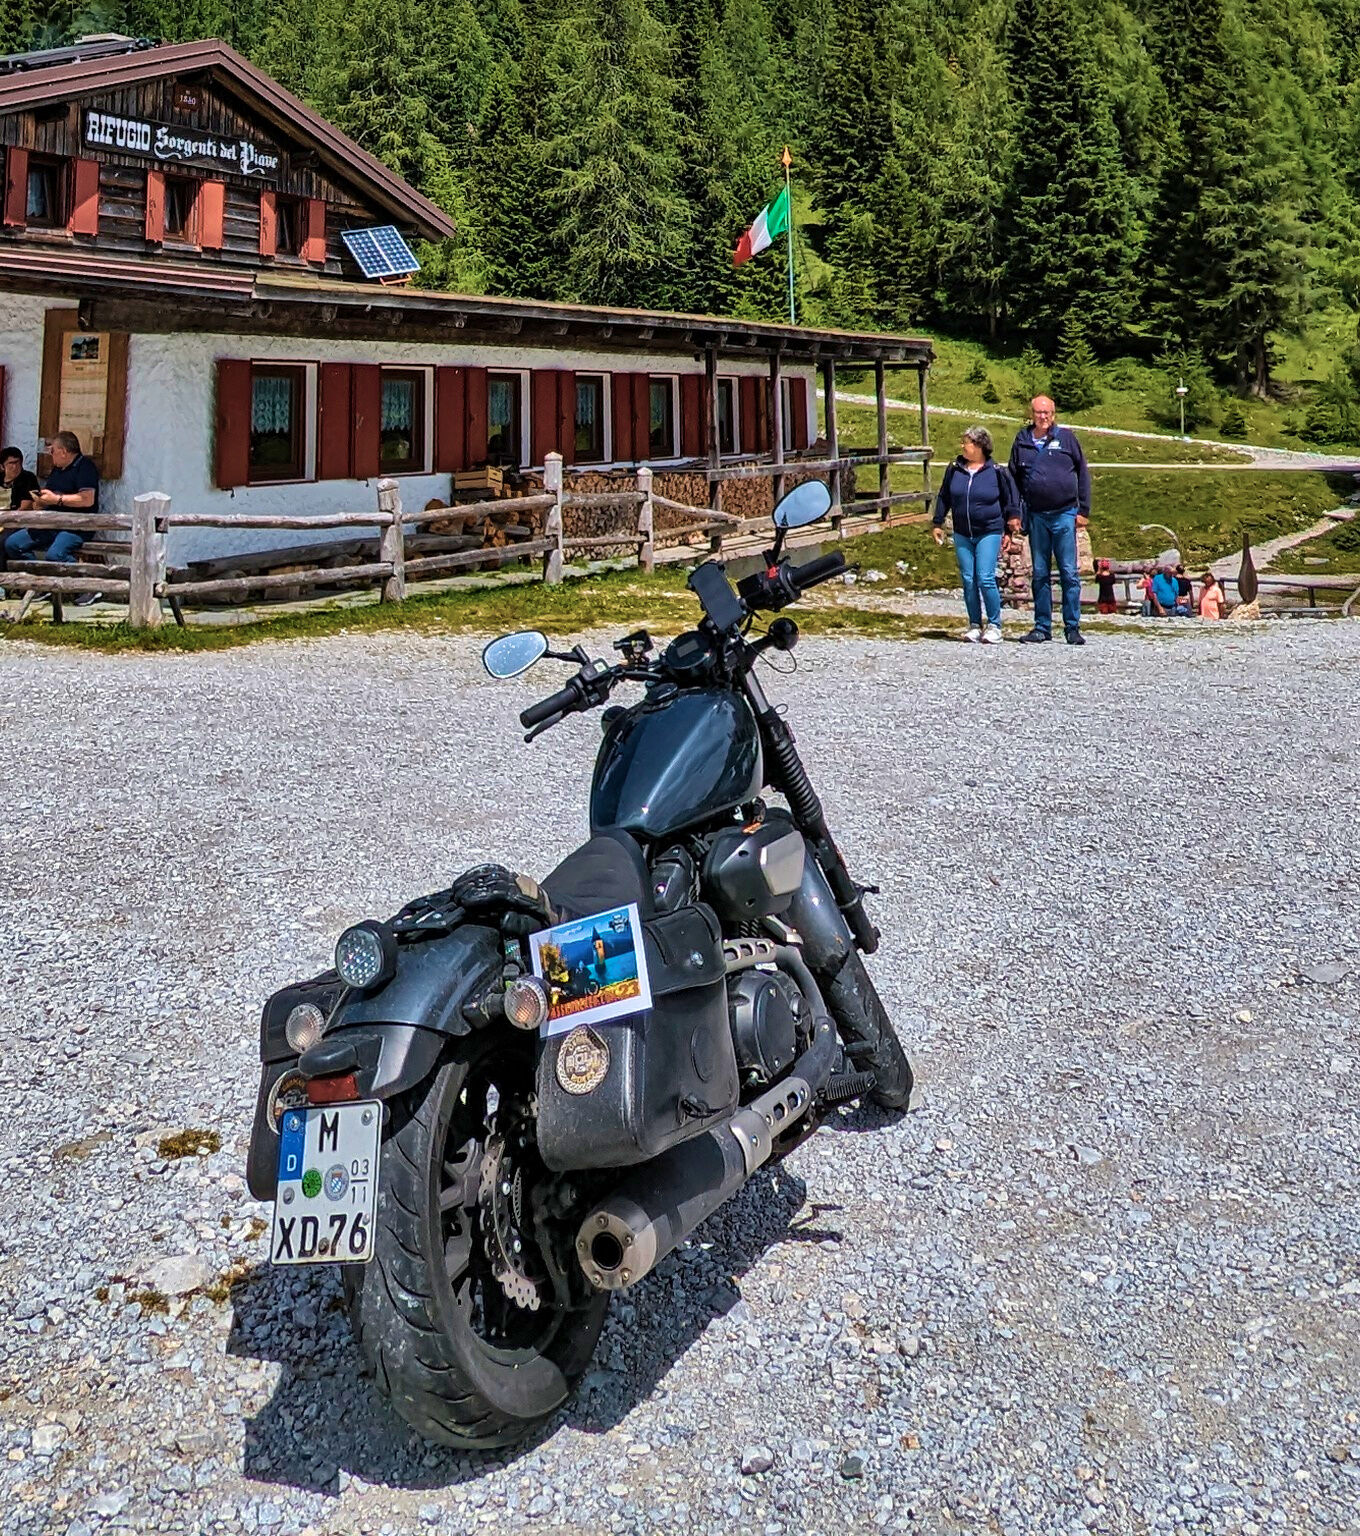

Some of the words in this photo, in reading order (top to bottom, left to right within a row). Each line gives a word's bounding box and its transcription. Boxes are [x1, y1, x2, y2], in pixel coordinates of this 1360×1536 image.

[87, 112, 151, 151] RIFUGIO
[154, 127, 217, 159] Sorgenti
[220, 143, 238, 161] del
[239, 141, 278, 175] Piave
[319, 1111, 340, 1152] M
[287, 1154, 296, 1172] D
[351, 1159, 369, 1176] 03
[351, 1186, 367, 1204] 11
